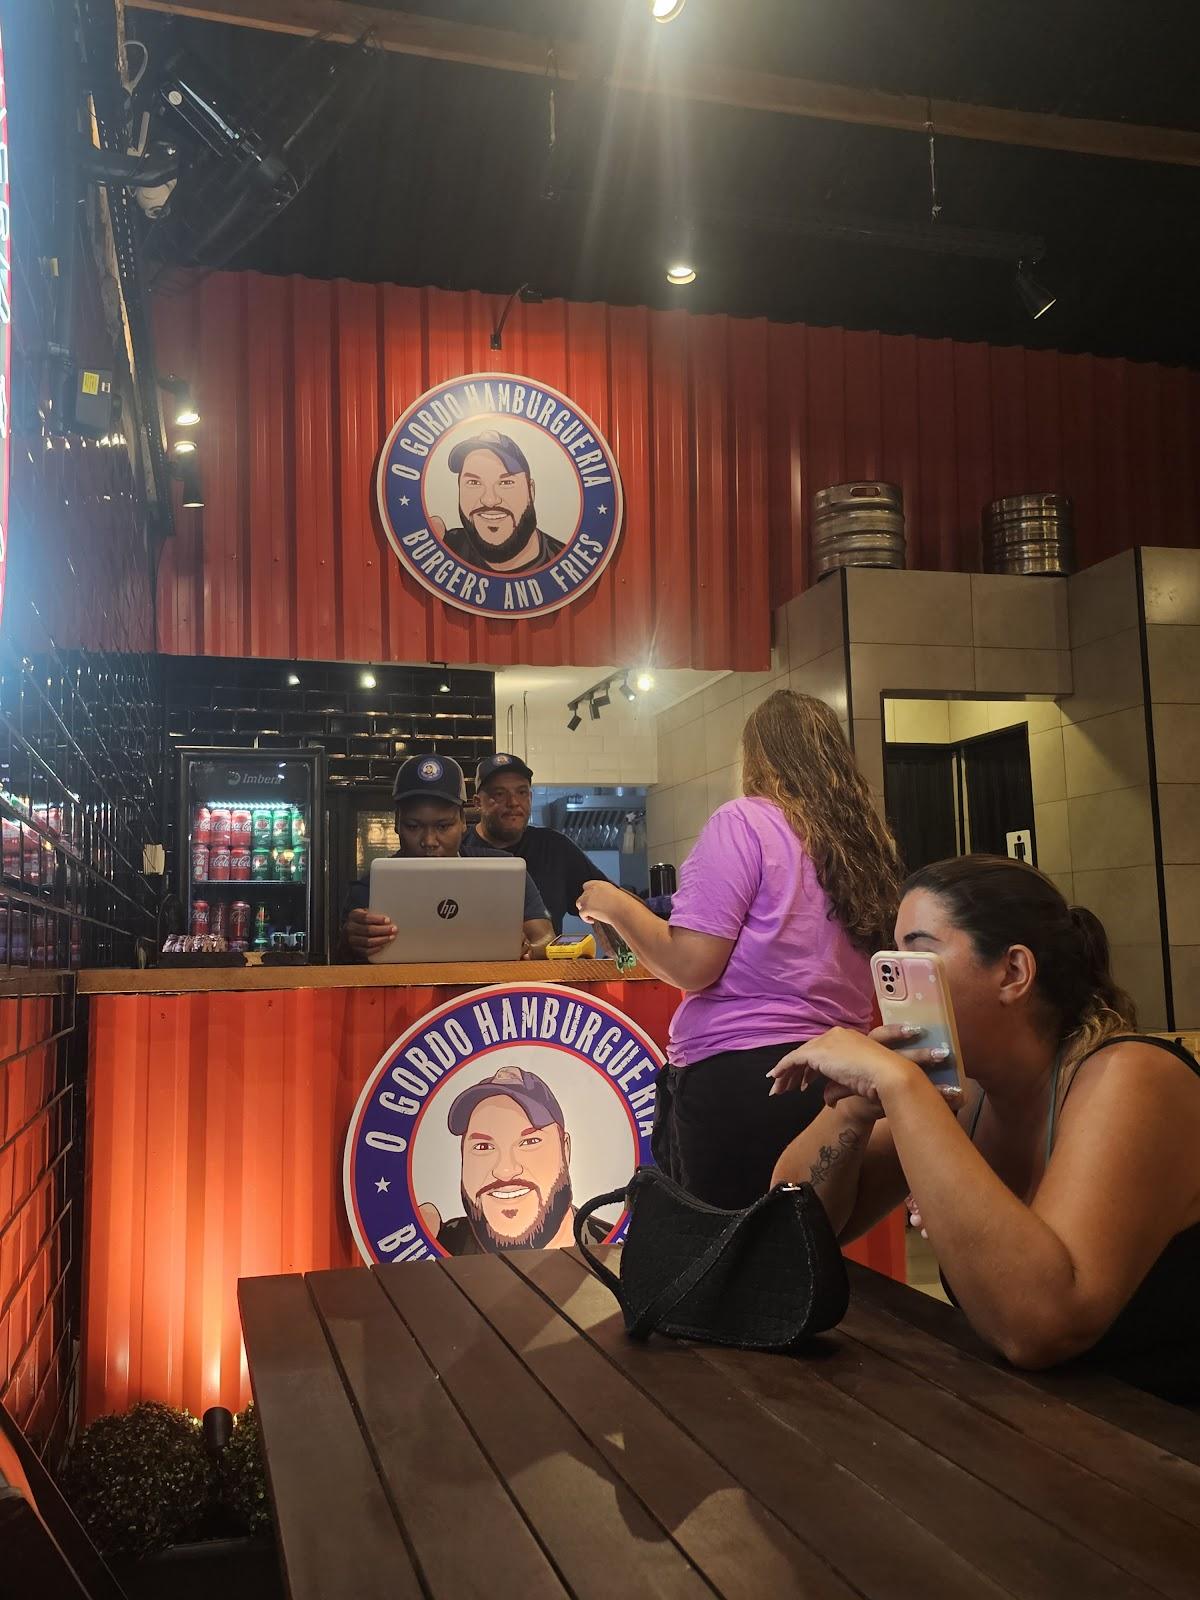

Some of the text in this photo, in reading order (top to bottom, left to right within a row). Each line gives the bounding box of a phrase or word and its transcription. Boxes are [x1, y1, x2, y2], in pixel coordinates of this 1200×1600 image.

[392, 382, 611, 488] O GORDO HAMBURGUERIA
[401, 528, 604, 610] BURGERS AND FRIES
[440, 898, 456, 919] hp
[378, 1018, 474, 1117] GORDO
[365, 1130, 408, 1153] O
